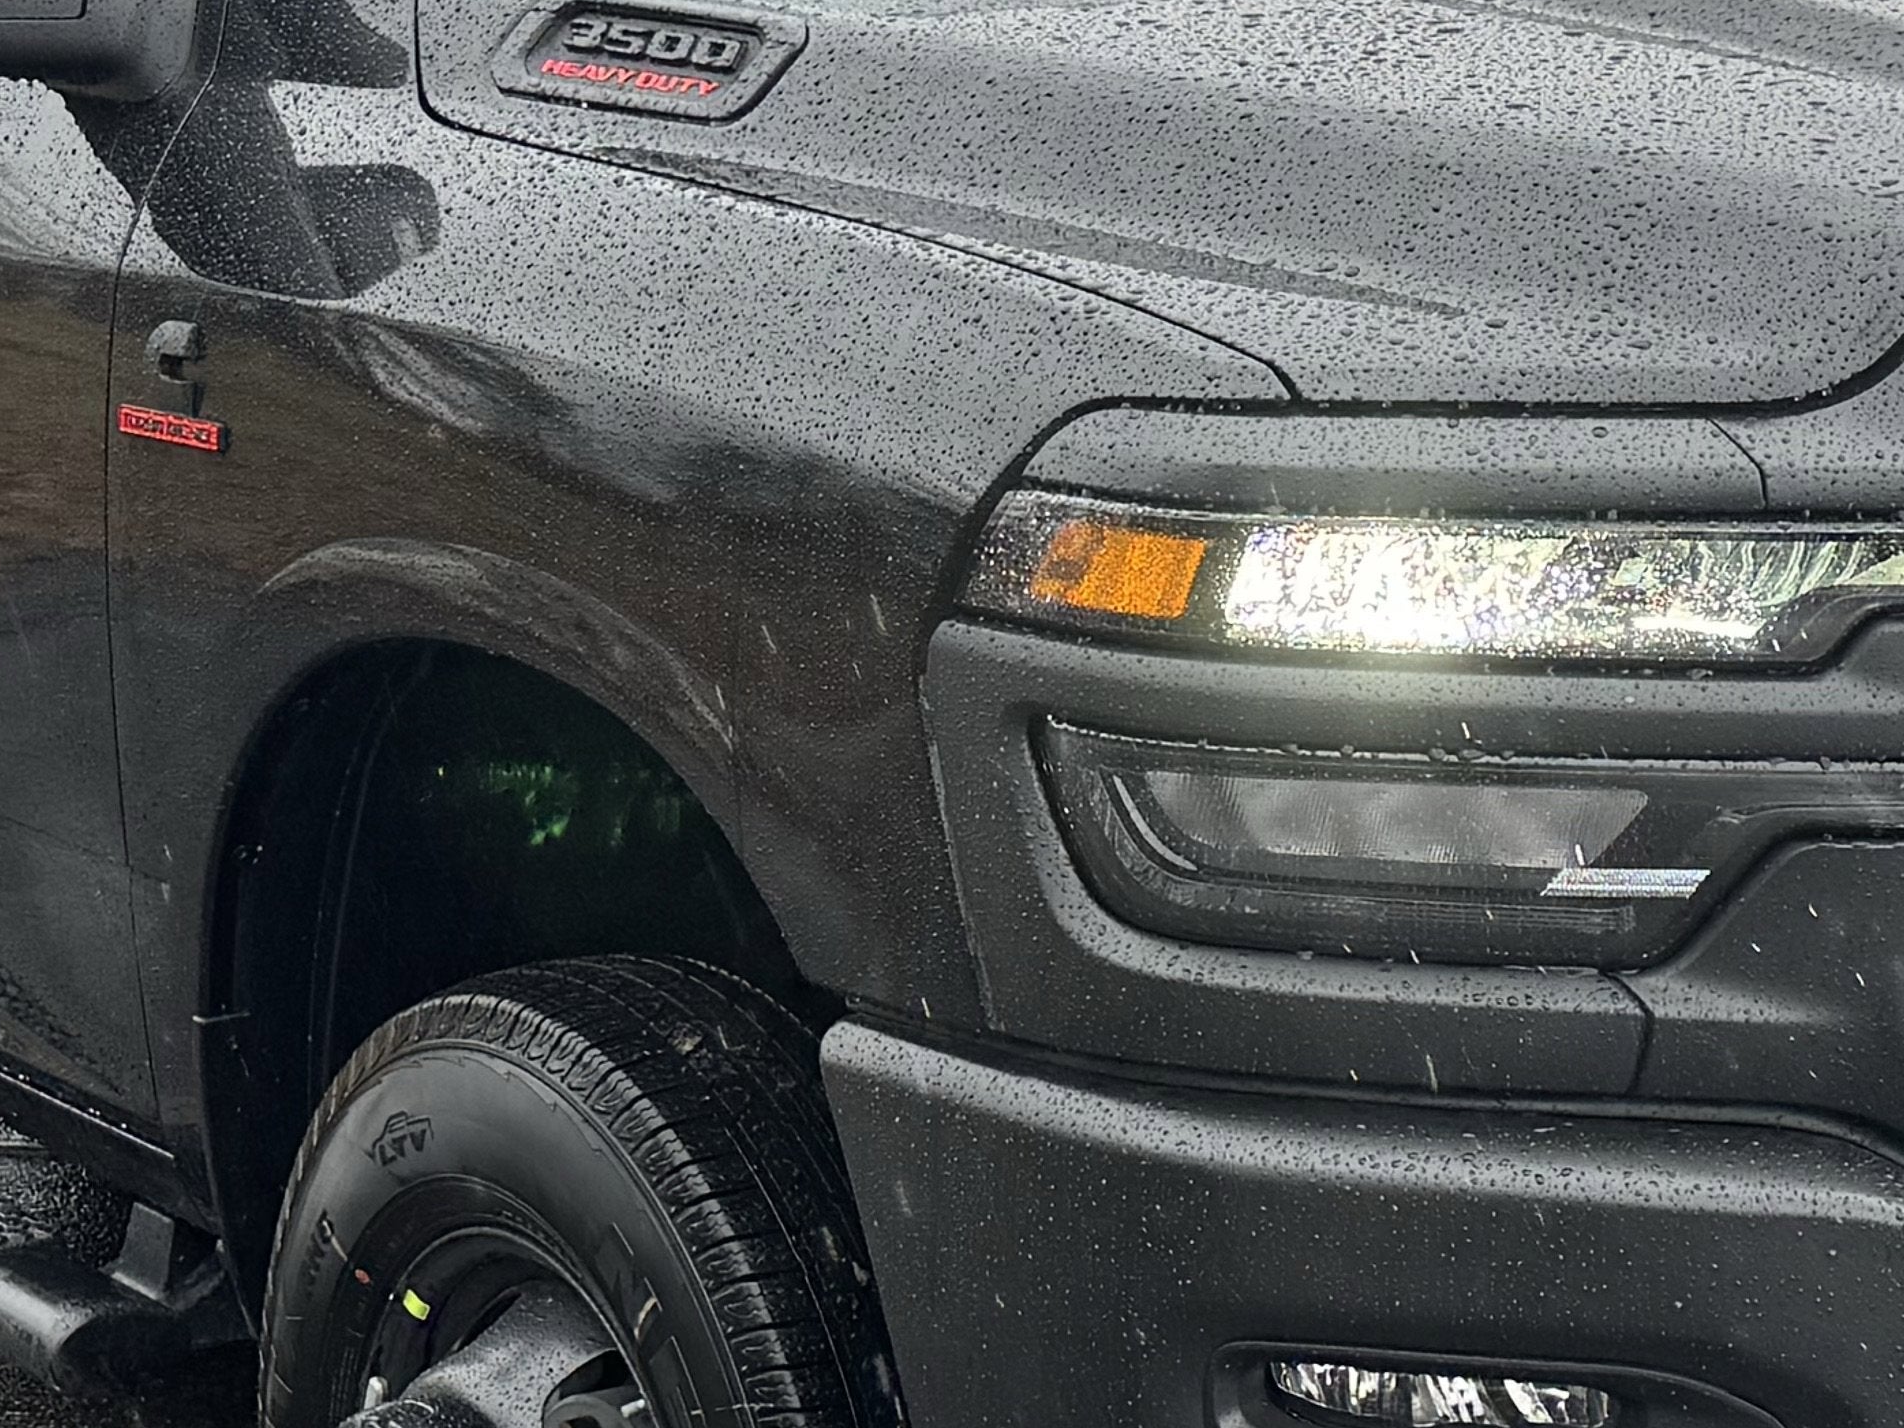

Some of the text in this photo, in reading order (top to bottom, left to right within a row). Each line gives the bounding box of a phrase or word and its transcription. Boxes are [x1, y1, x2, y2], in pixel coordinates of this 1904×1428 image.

[562, 18, 746, 69] 3500
[541, 59, 721, 98] HEAVY DUTY
